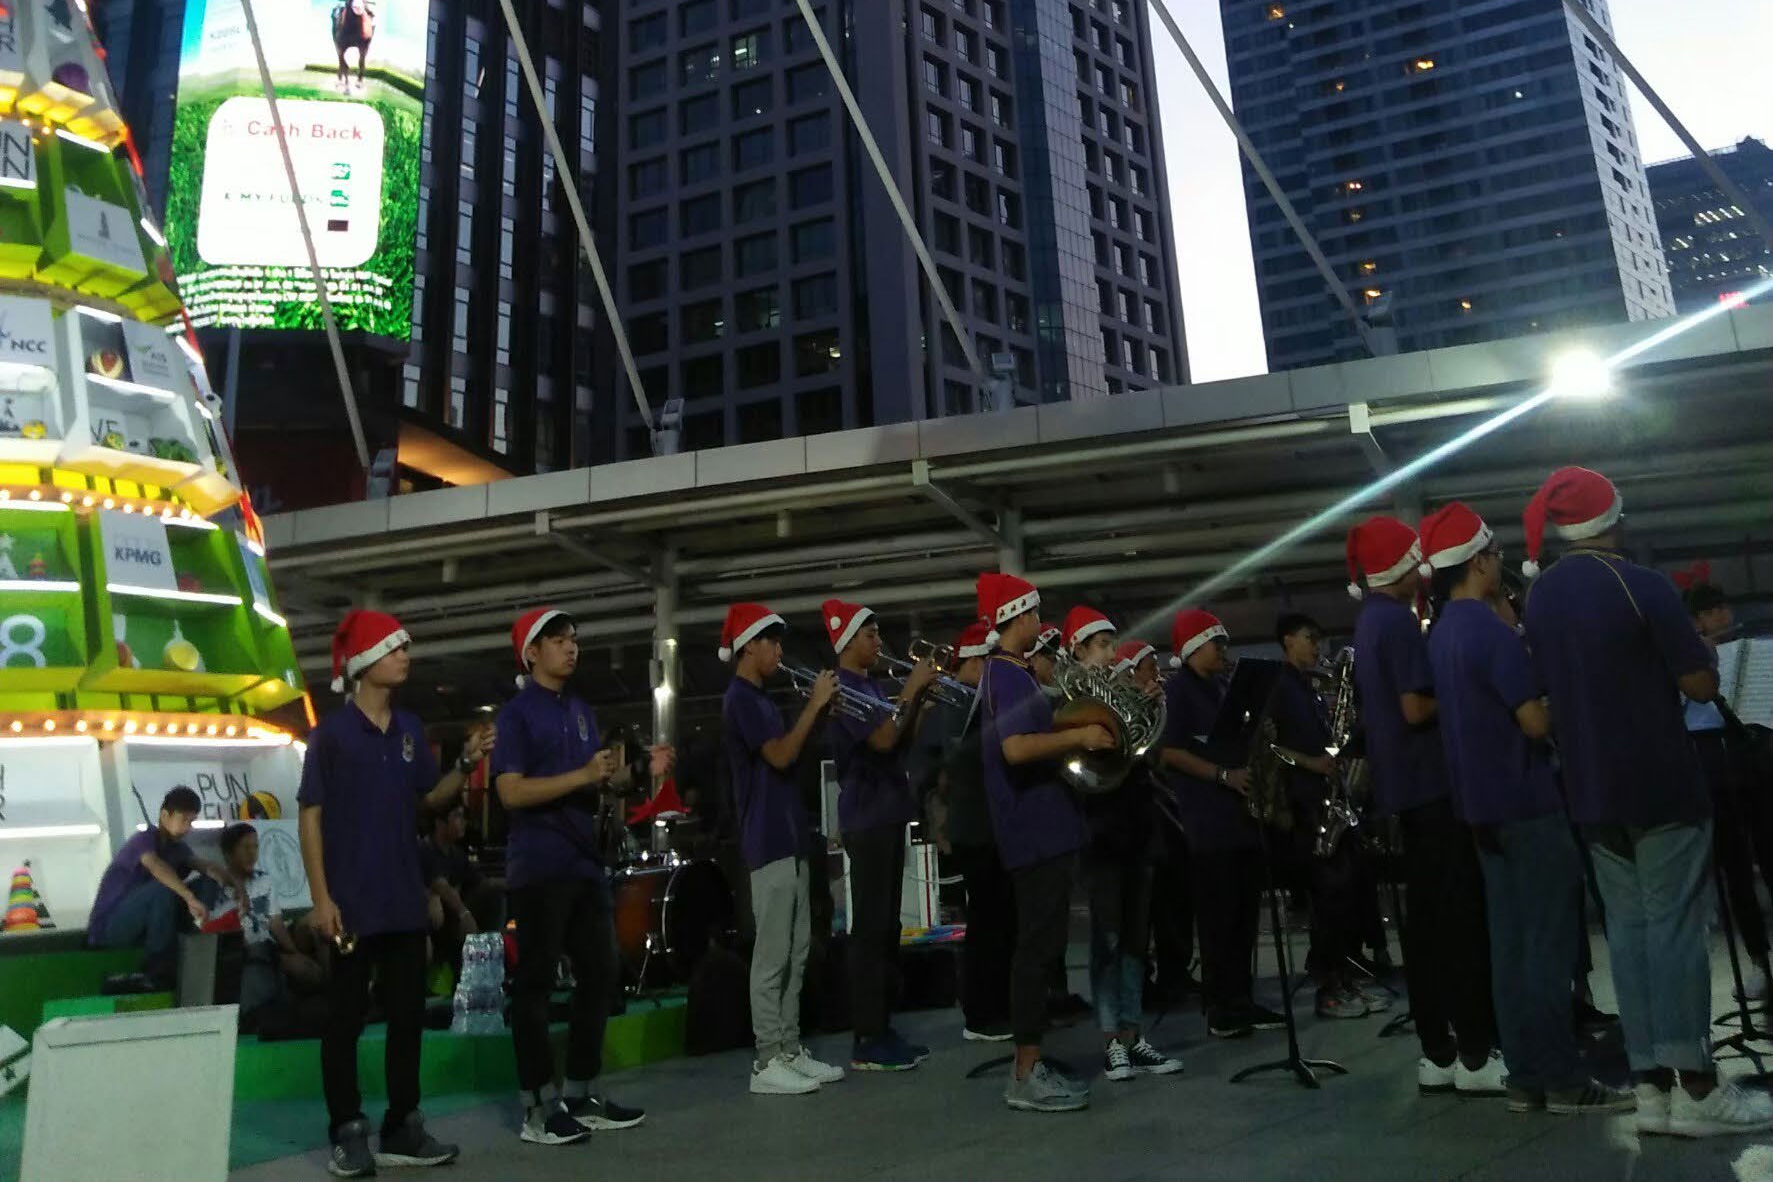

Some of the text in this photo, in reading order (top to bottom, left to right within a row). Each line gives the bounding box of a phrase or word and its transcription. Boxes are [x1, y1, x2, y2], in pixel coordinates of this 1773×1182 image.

[248, 120, 300, 138] Cah
[312, 123, 362, 140] Back
[11, 338, 47, 353] NCC
[114, 546, 162, 566] KPMG
[197, 772, 252, 803] PUN
